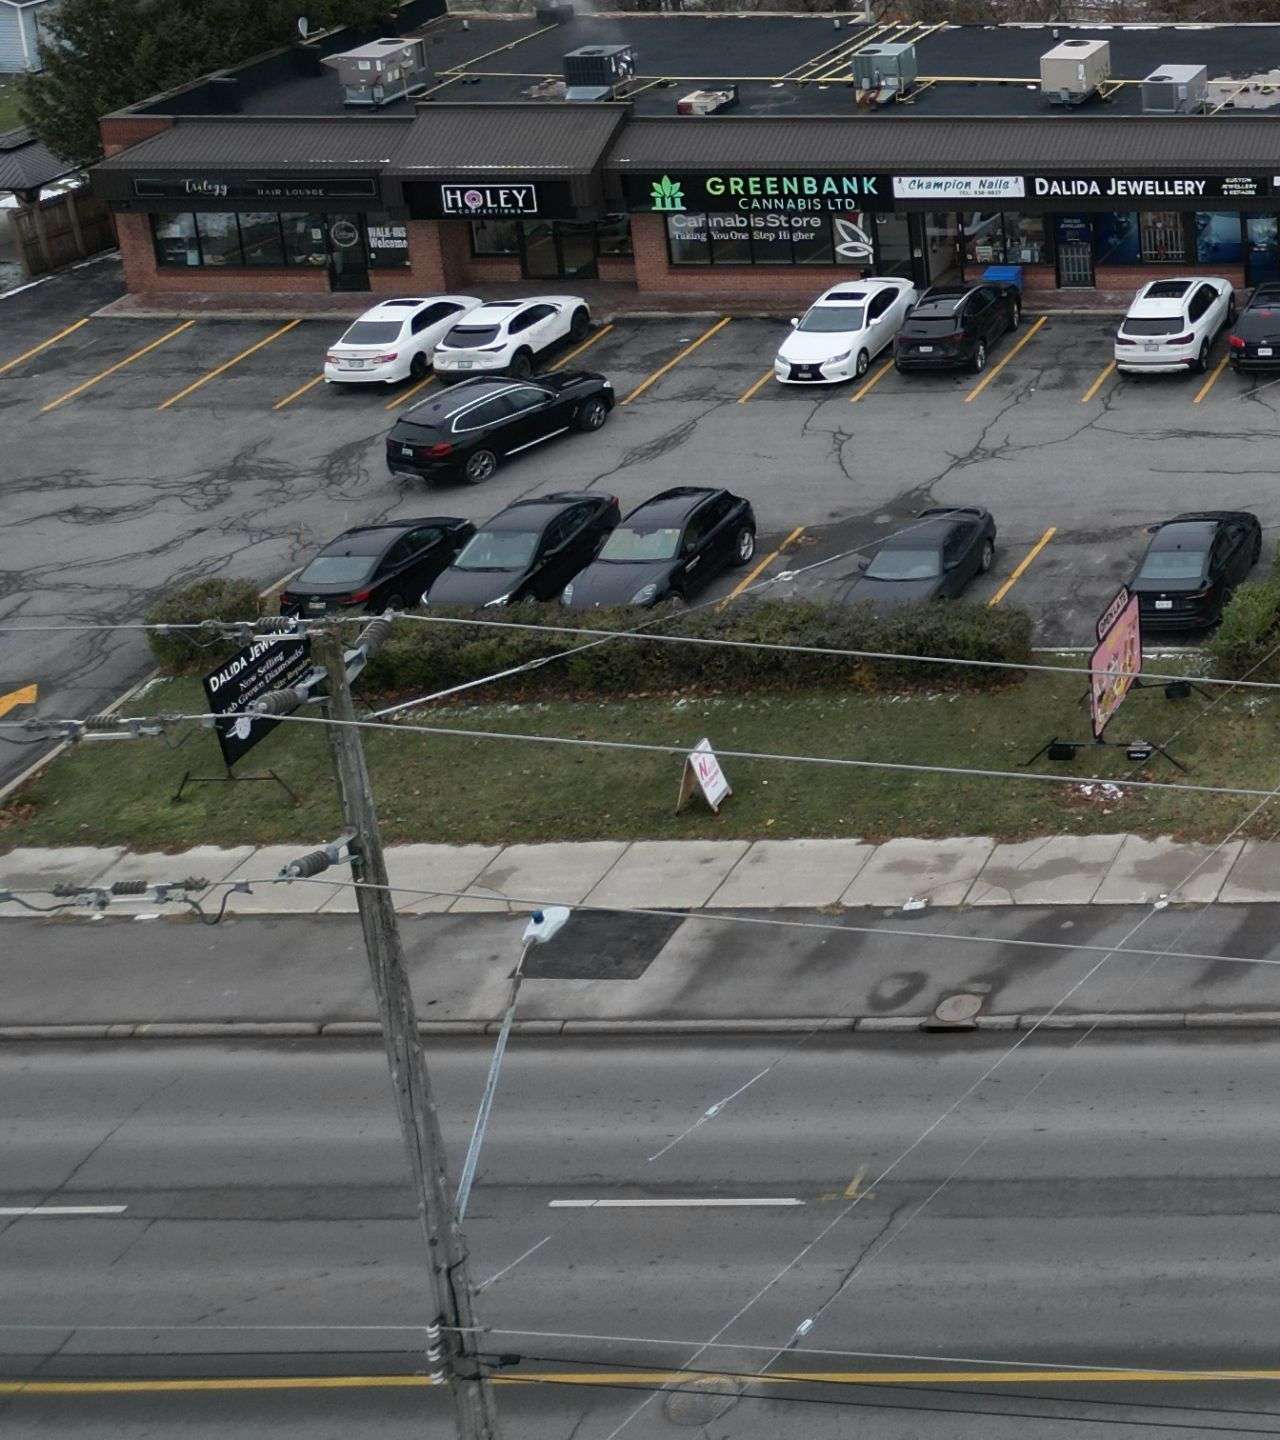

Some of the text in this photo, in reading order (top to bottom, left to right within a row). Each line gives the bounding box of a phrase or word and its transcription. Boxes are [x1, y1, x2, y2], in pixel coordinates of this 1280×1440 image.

[182, 179, 230, 197] Trilogy
[257, 188, 281, 196] HAIR
[705, 176, 879, 195] GREENBANK
[908, 178, 1010, 192] Champion Nails
[1034, 177, 1206, 196] DALIDA JEWELLERY
[445, 189, 527, 208] HOLEY
[738, 198, 856, 210] CANNABIS LTD
[671, 213, 822, 228] Cannabis Store
[369, 237, 408, 248] Welcome
[674, 231, 707, 242] Taking
[753, 231, 776, 242] Step
[257, 650, 285, 677] Selling
[209, 656, 248, 693] DALIDA
[238, 680, 265, 705] Grown
